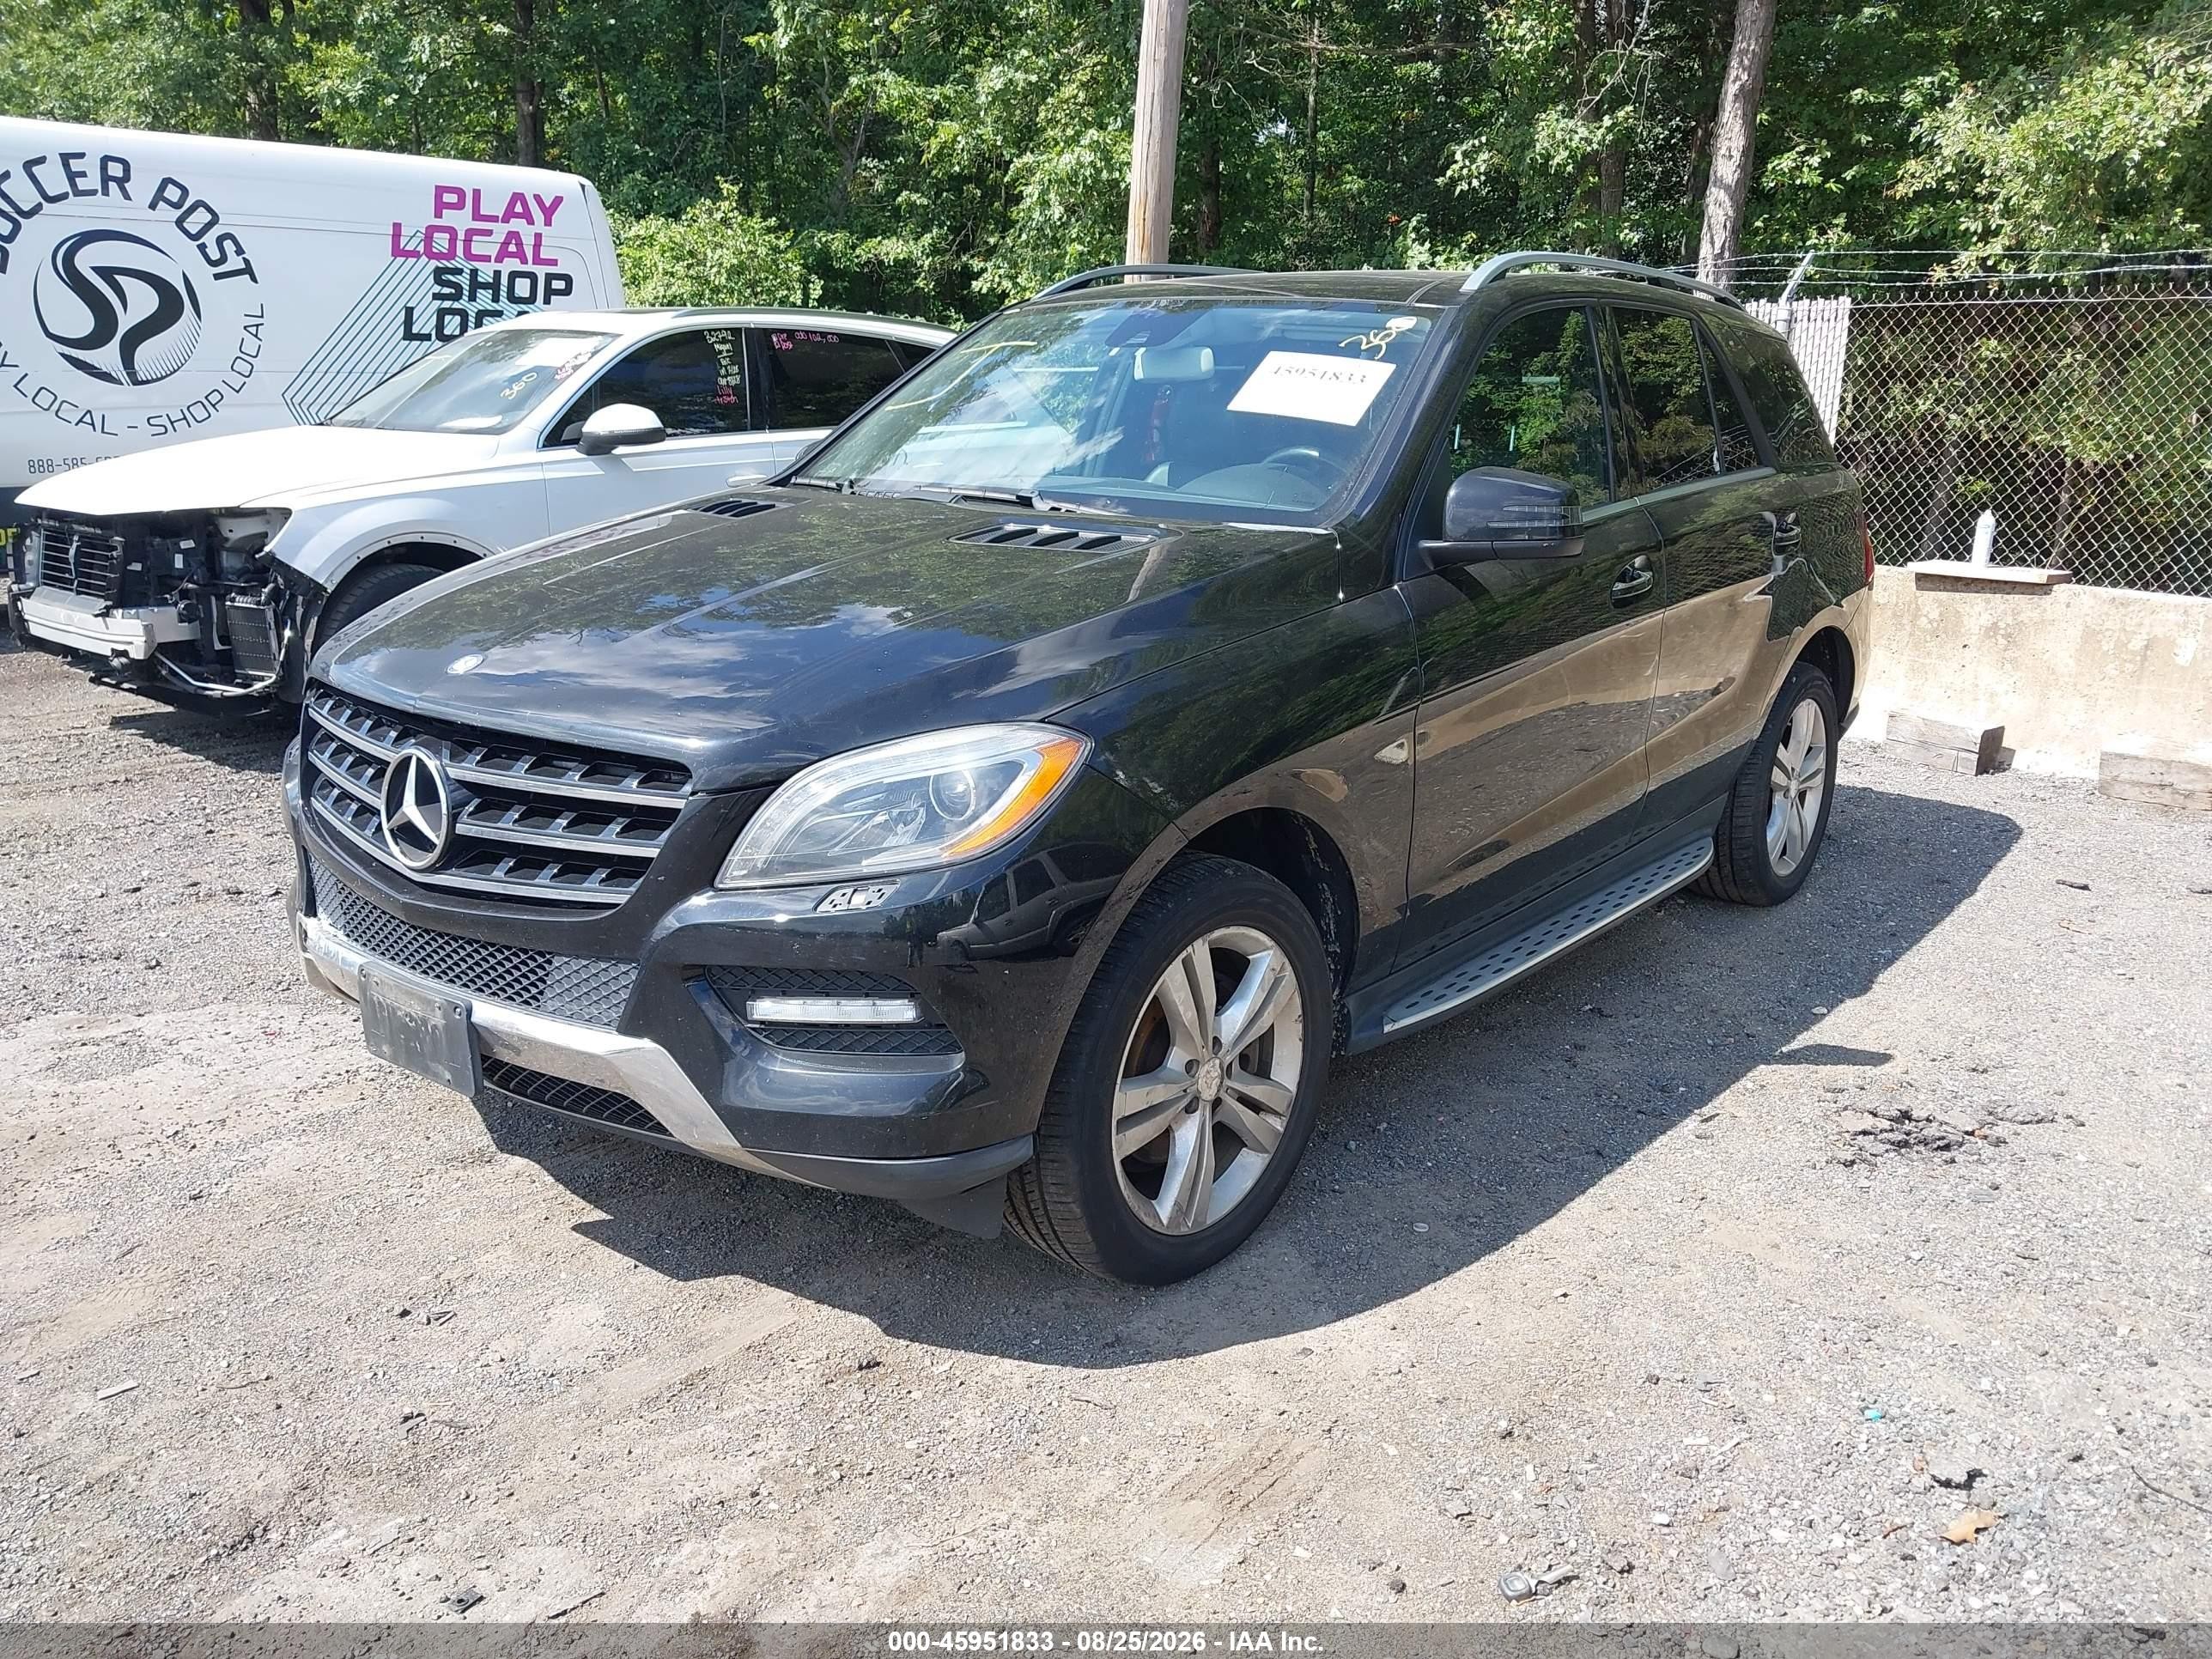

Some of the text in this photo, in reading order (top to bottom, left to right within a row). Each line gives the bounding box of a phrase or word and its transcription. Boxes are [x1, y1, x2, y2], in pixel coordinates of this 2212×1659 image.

[434, 185, 564, 227] PLAY
[148, 177, 259, 284] POST
[391, 222, 559, 267] LOCAL
[432, 266, 574, 305] SHOP
[13, 373, 118, 436] LOCAL
[146, 388, 224, 436] SHOP
[222, 303, 264, 393] LOCAL
